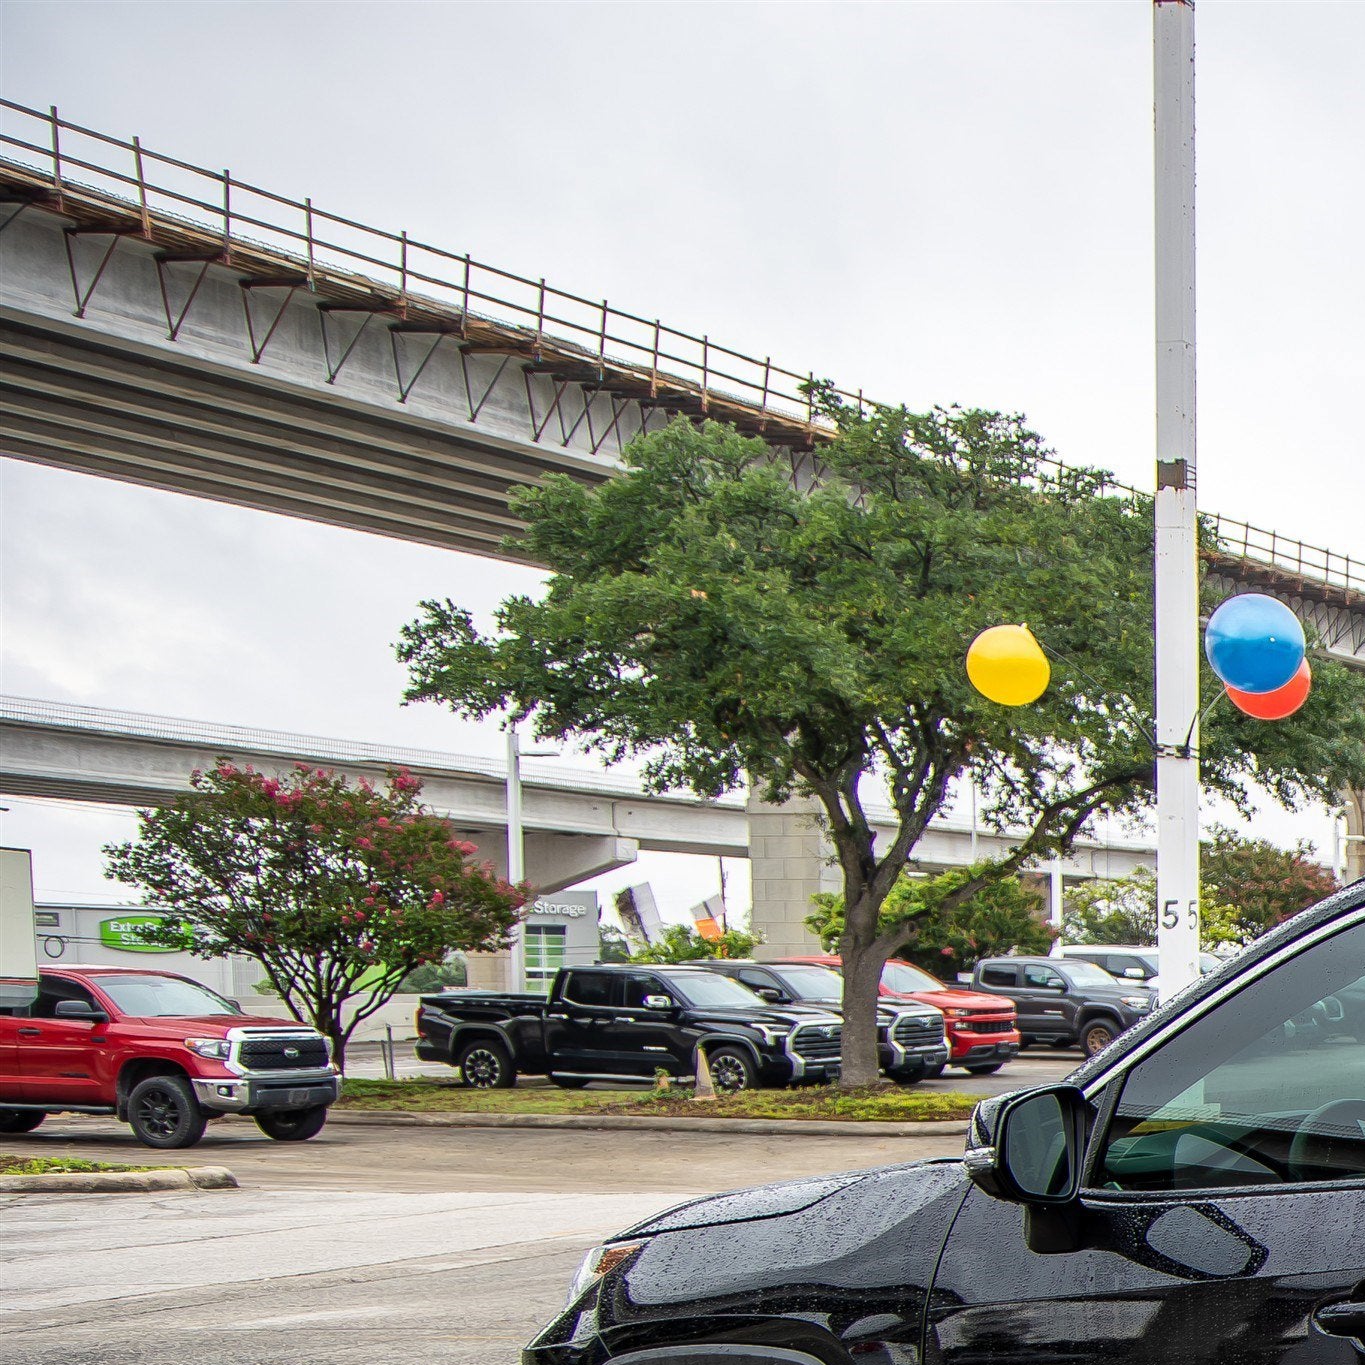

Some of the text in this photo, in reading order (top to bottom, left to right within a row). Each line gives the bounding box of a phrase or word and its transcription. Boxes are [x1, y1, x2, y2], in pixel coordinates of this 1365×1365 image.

[534, 901, 587, 918] Storage
[1162, 900, 1179, 930] 5
[1188, 900, 1198, 930] 5
